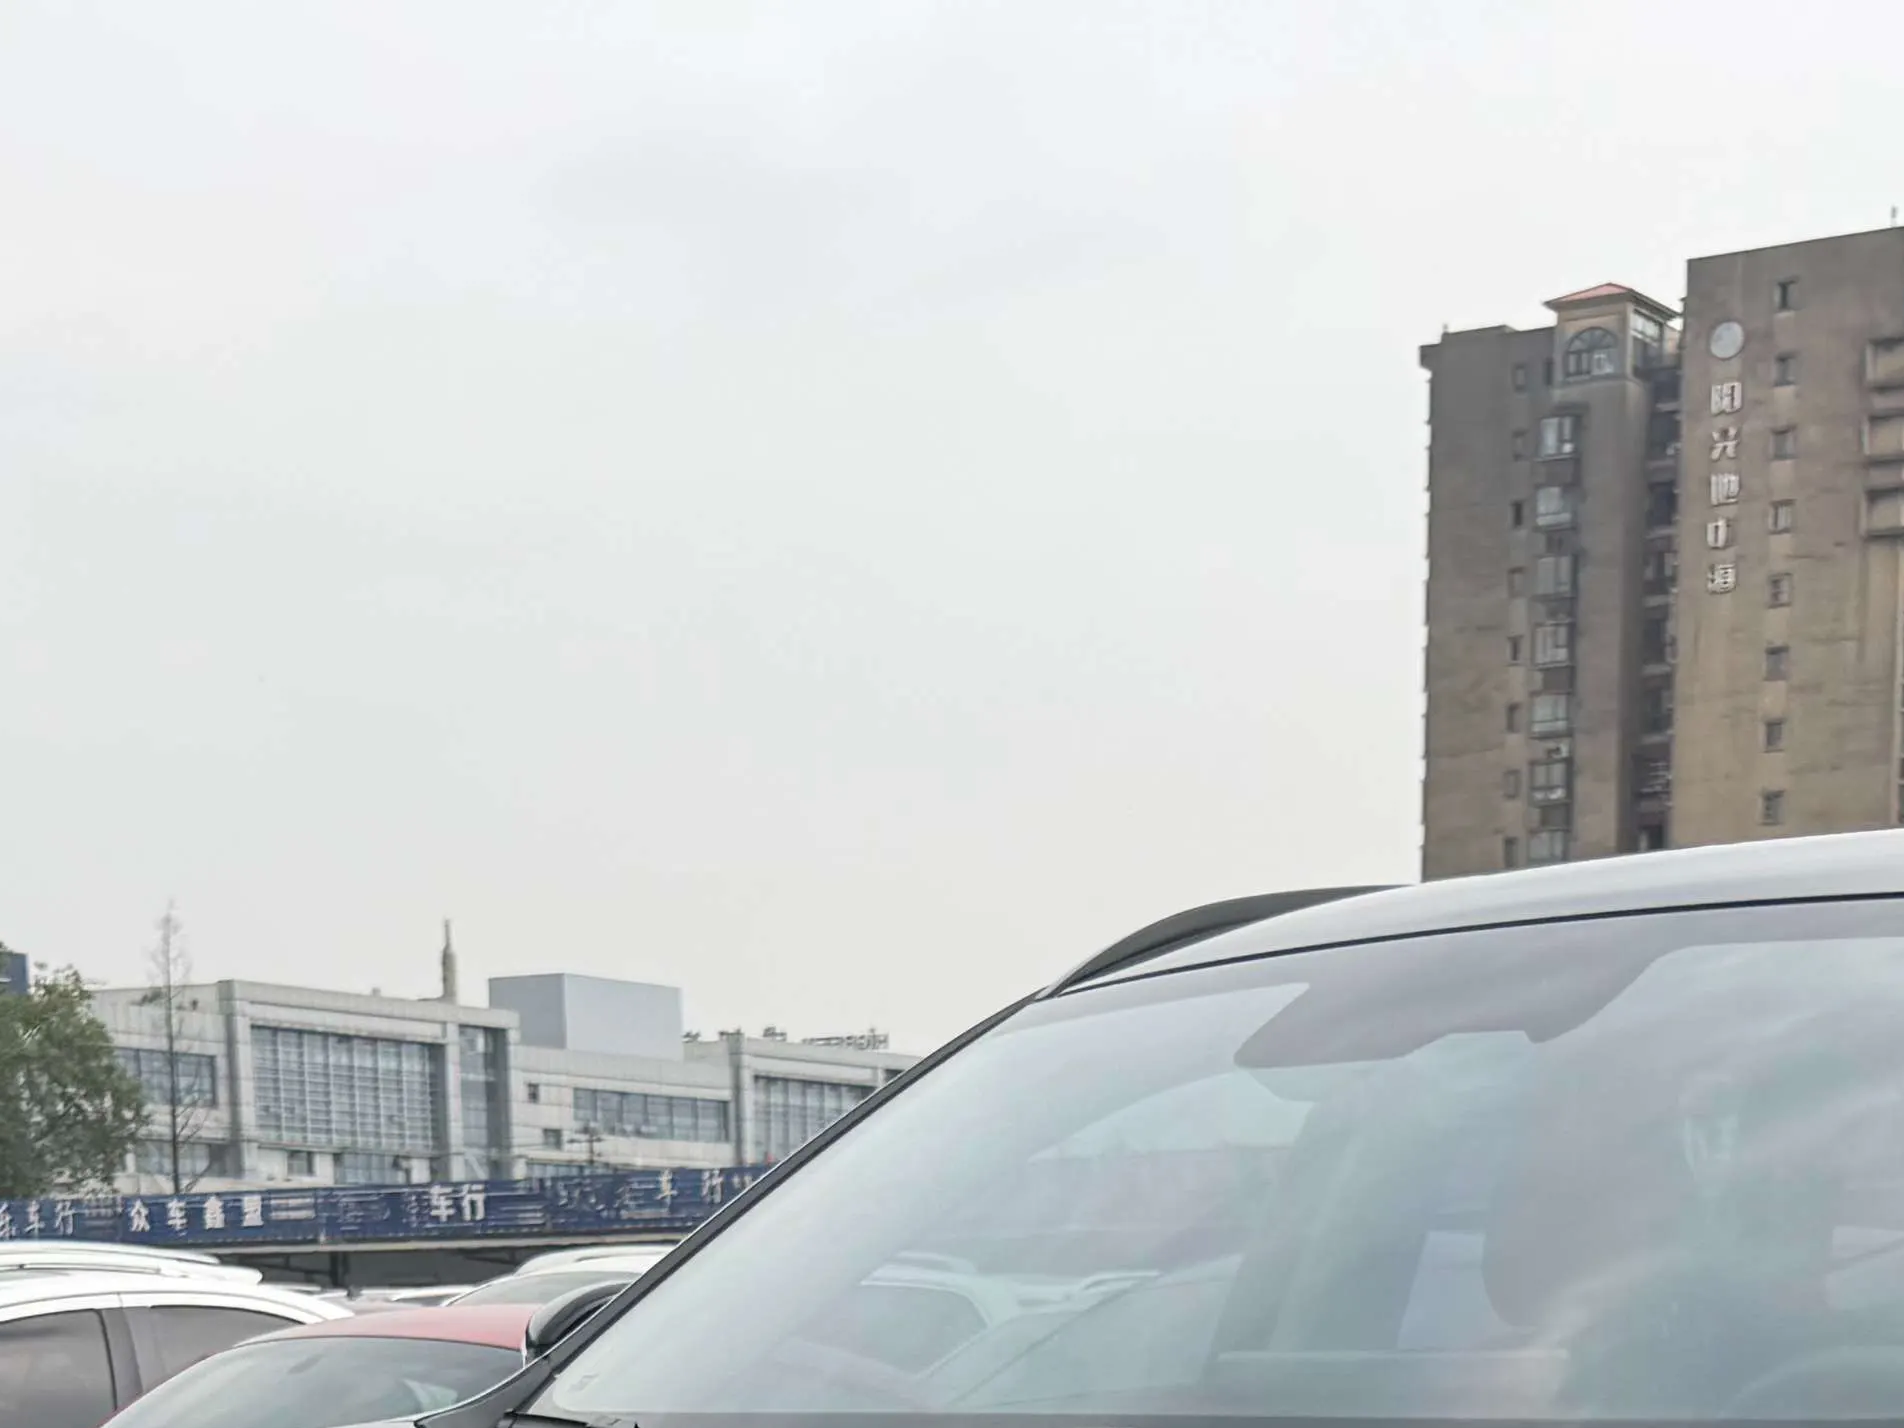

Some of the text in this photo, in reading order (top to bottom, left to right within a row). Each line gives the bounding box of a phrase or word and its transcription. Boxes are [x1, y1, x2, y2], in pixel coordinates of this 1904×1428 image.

[1707, 381, 1742, 594] 阳光地中海
